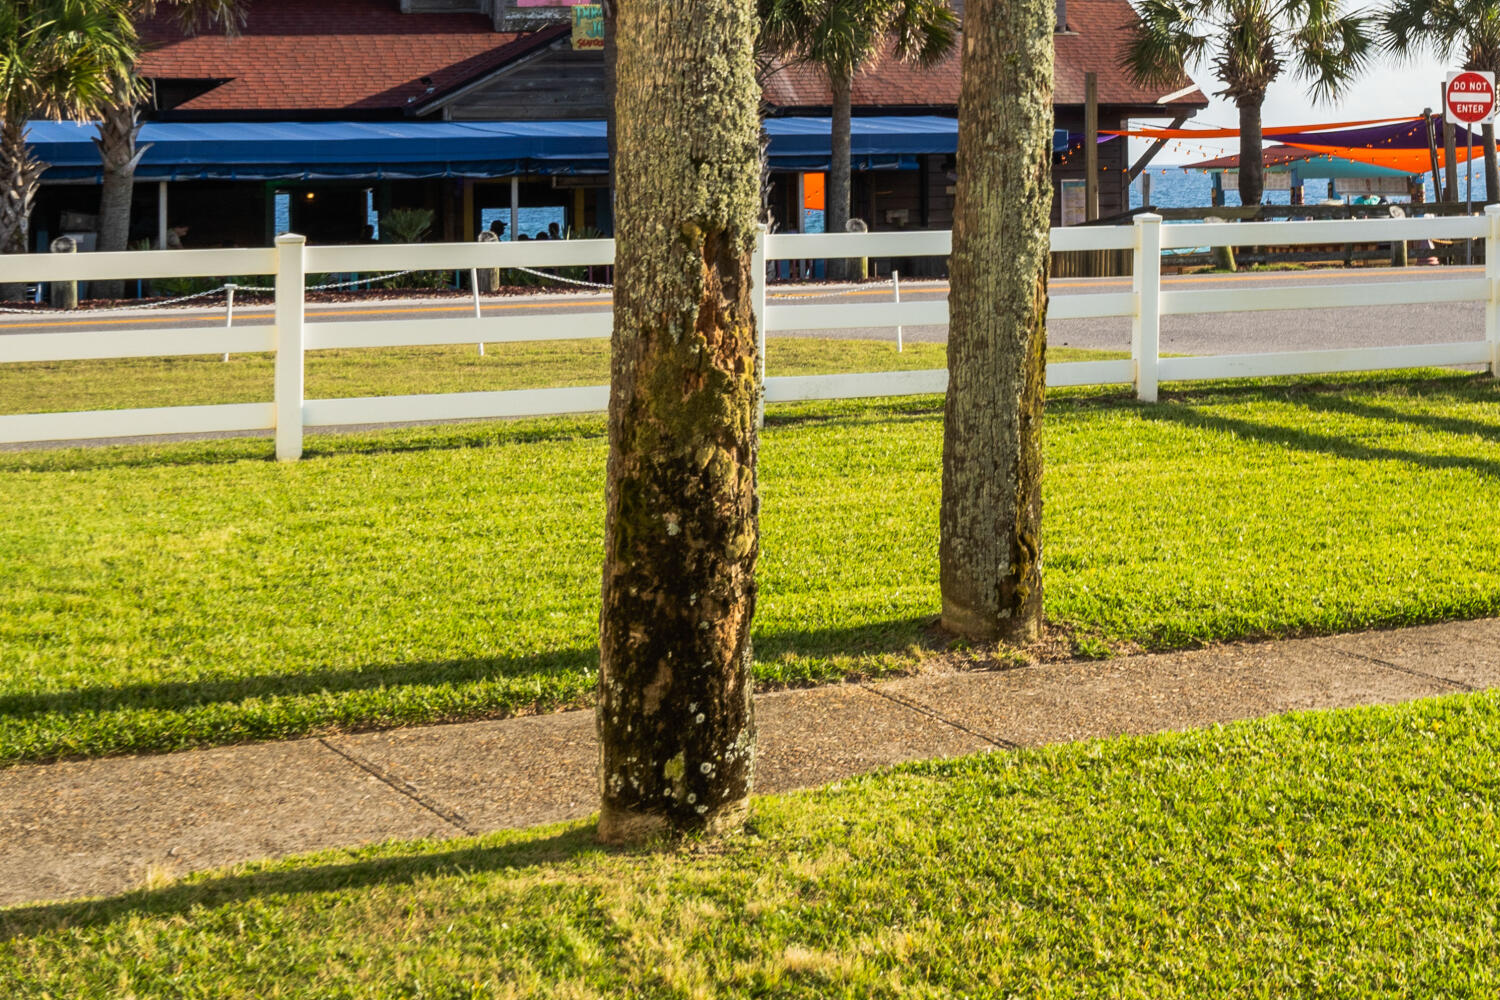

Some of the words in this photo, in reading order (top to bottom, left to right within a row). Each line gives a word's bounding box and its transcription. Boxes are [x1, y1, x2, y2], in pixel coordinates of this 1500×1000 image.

[1453, 81, 1466, 91] DO
[1469, 81, 1487, 91] NOT
[1456, 104, 1484, 113] ENTER
